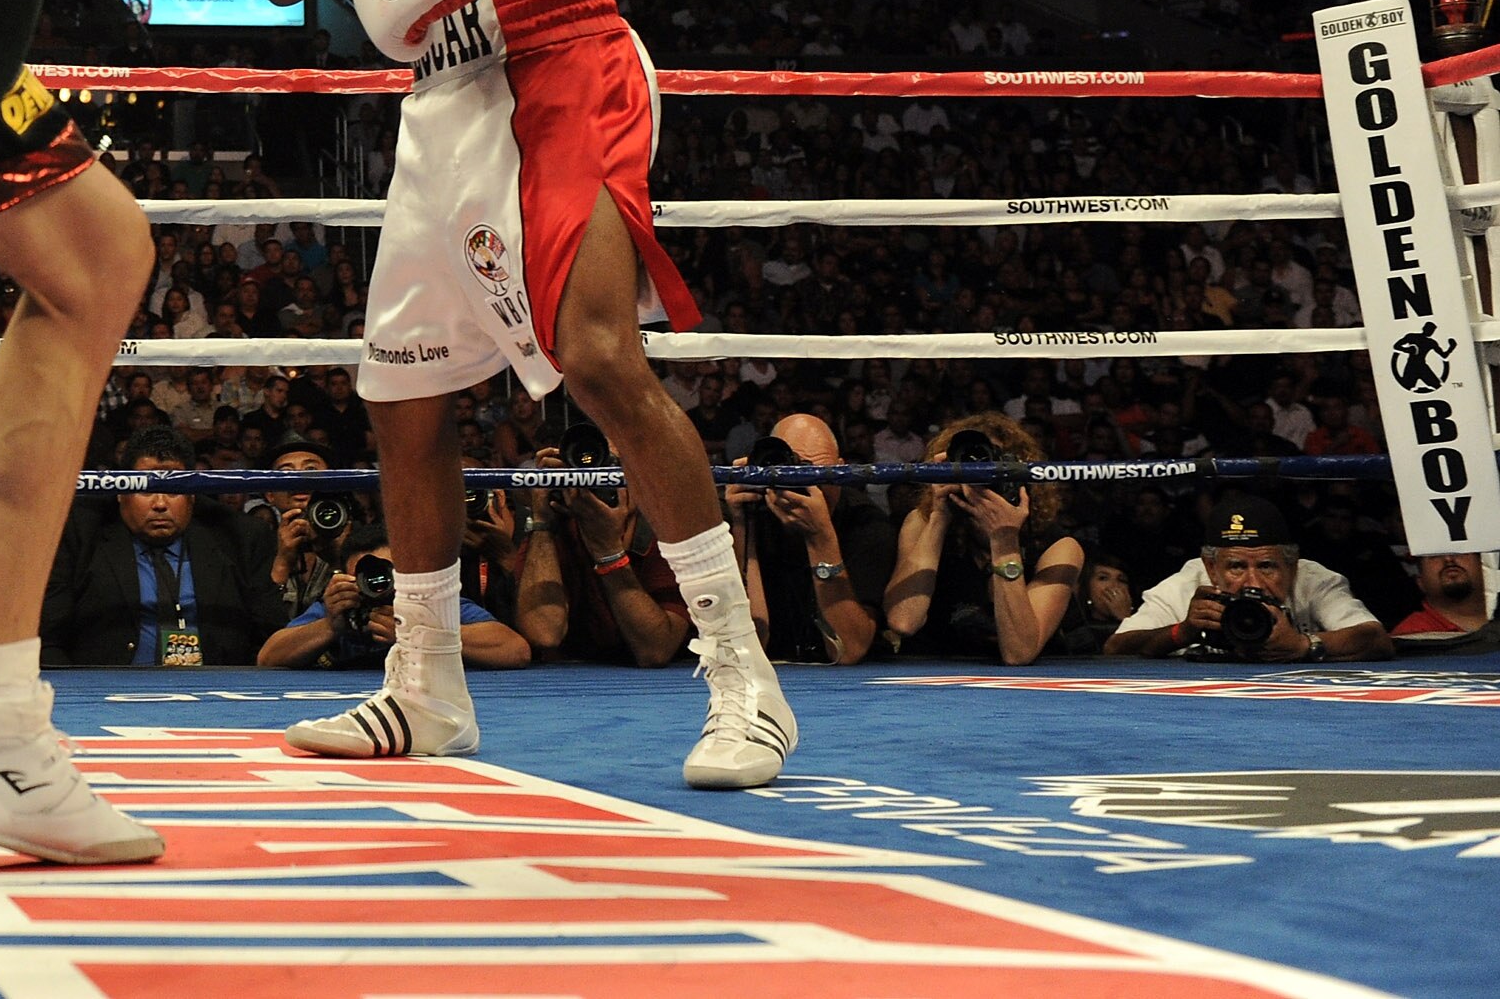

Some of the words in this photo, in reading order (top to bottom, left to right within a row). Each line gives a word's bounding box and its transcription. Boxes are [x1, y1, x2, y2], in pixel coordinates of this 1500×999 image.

[1320, 18, 1364, 37] GOLDEN
[1381, 10, 1405, 25] BOY
[984, 71, 1145, 85] SOUTHWEST.COM
[1006, 198, 1170, 214] SOUTHWEST.COM
[1348, 41, 1434, 321] GOLDEN
[1409, 399, 1472, 543] BOY
[994, 332, 1158, 346] SOUTHWEST.COM
[418, 344, 450, 363] Love
[1030, 463, 1197, 482] SOUTHWEST.COM
